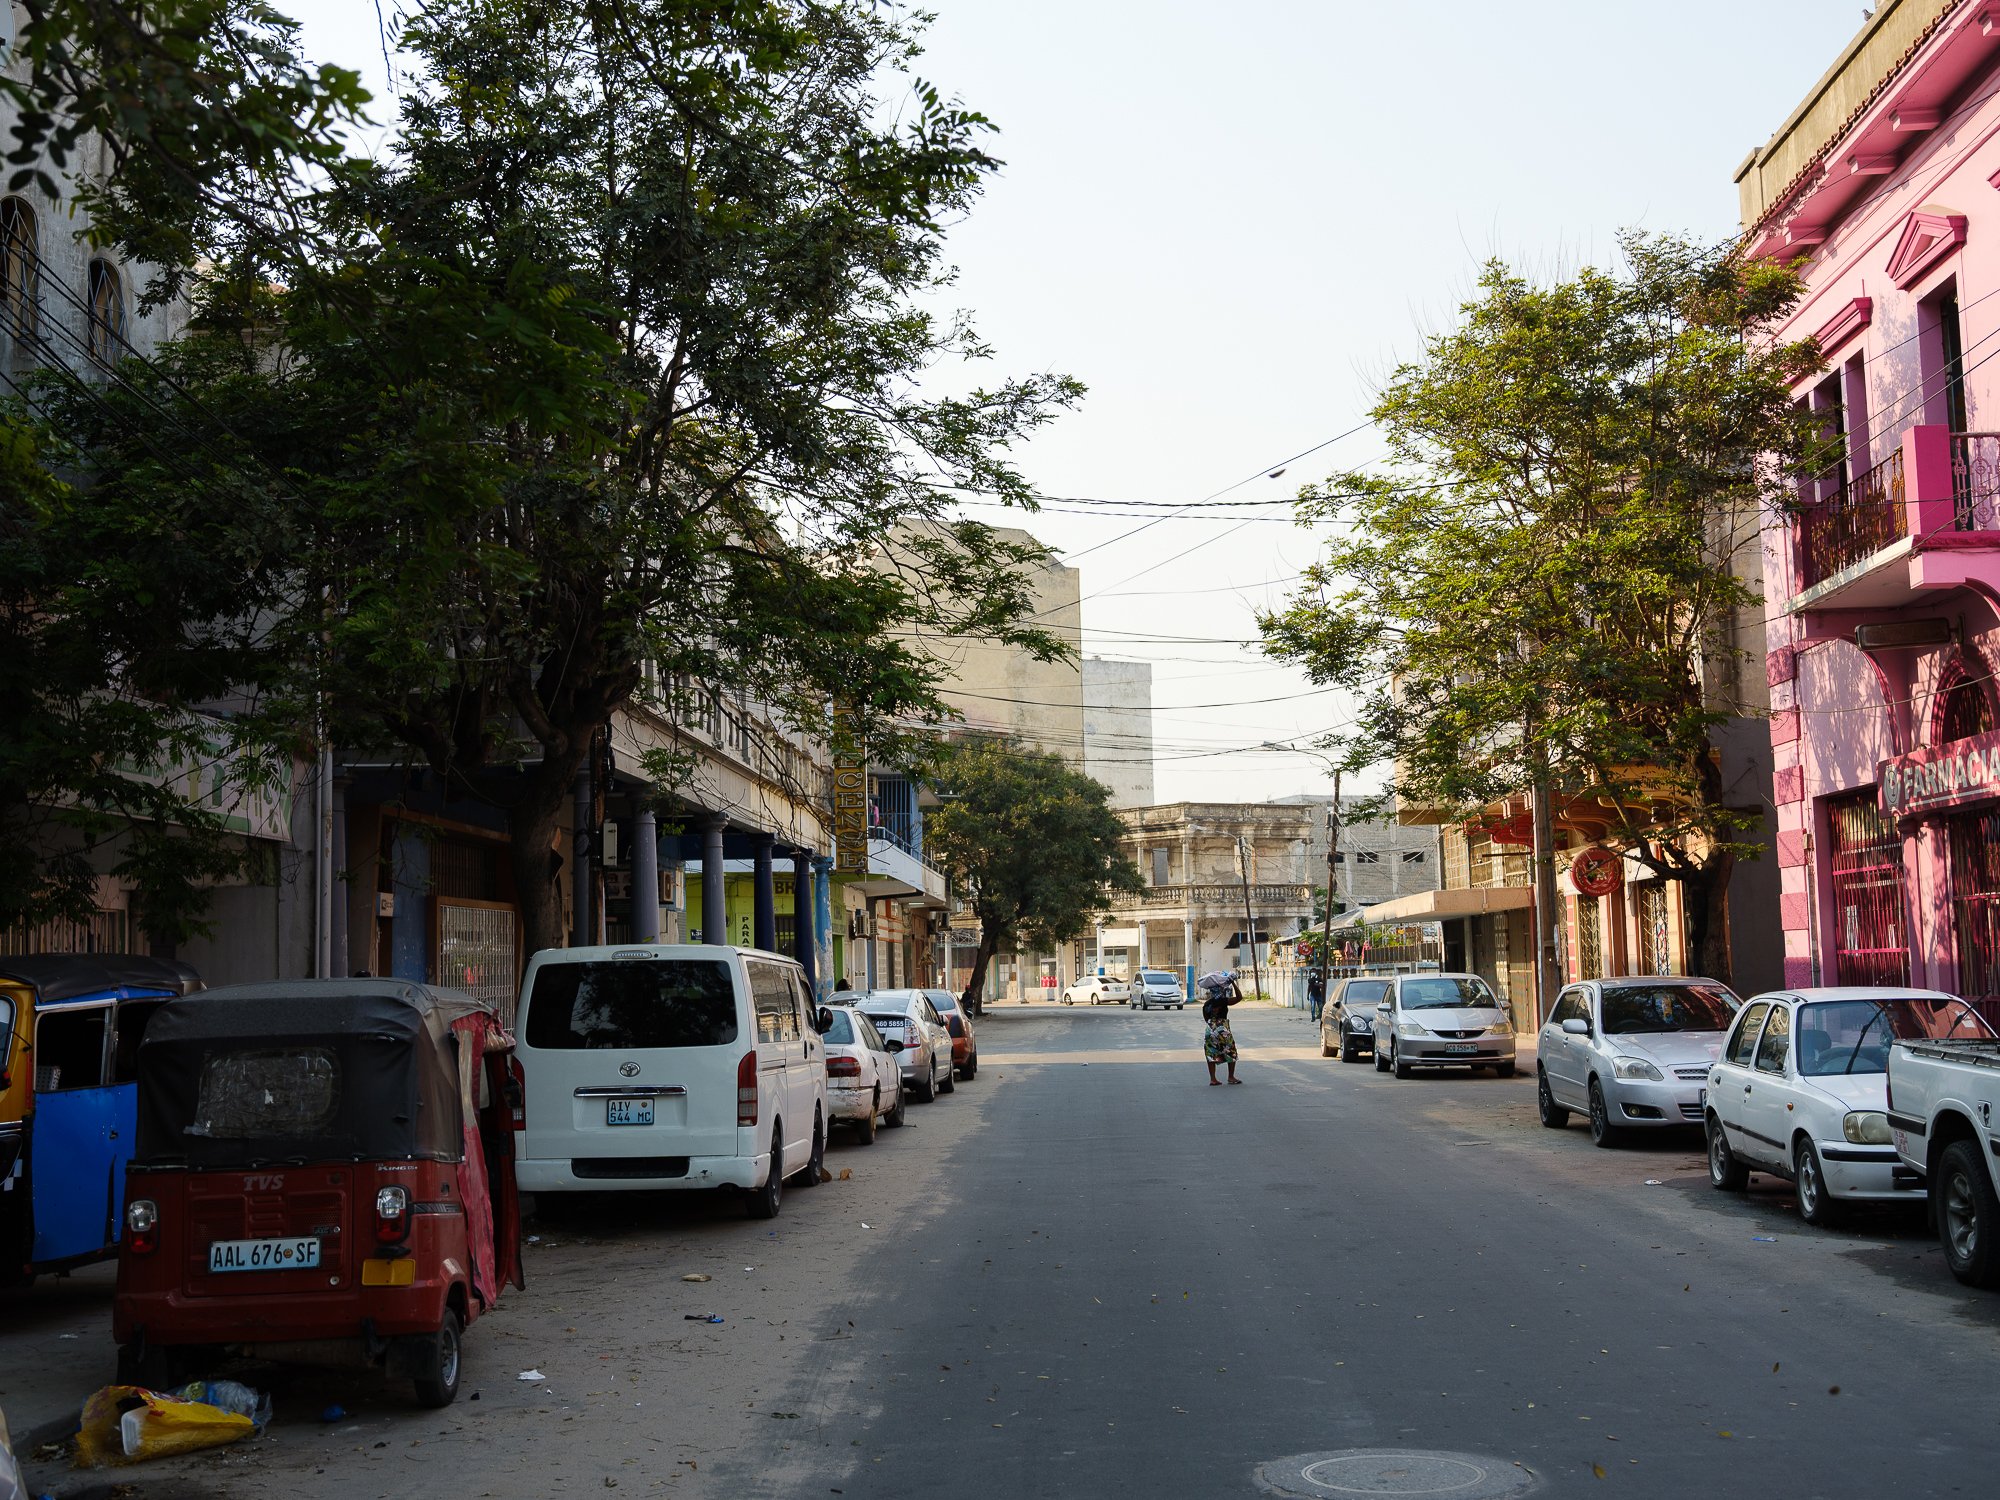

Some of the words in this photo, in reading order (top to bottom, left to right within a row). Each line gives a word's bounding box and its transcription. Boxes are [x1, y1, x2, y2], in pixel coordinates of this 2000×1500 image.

[1903, 747, 2000, 800] FARMÁCIA
[741, 916, 750, 947] PARA
[610, 1101, 631, 1112] AIY
[610, 1112, 631, 1123] 544
[637, 1111, 651, 1122] MC
[244, 1175, 284, 1191] TVS
[213, 1245, 246, 1268] AAL
[251, 1243, 283, 1265] 676
[295, 1241, 317, 1263] SF
